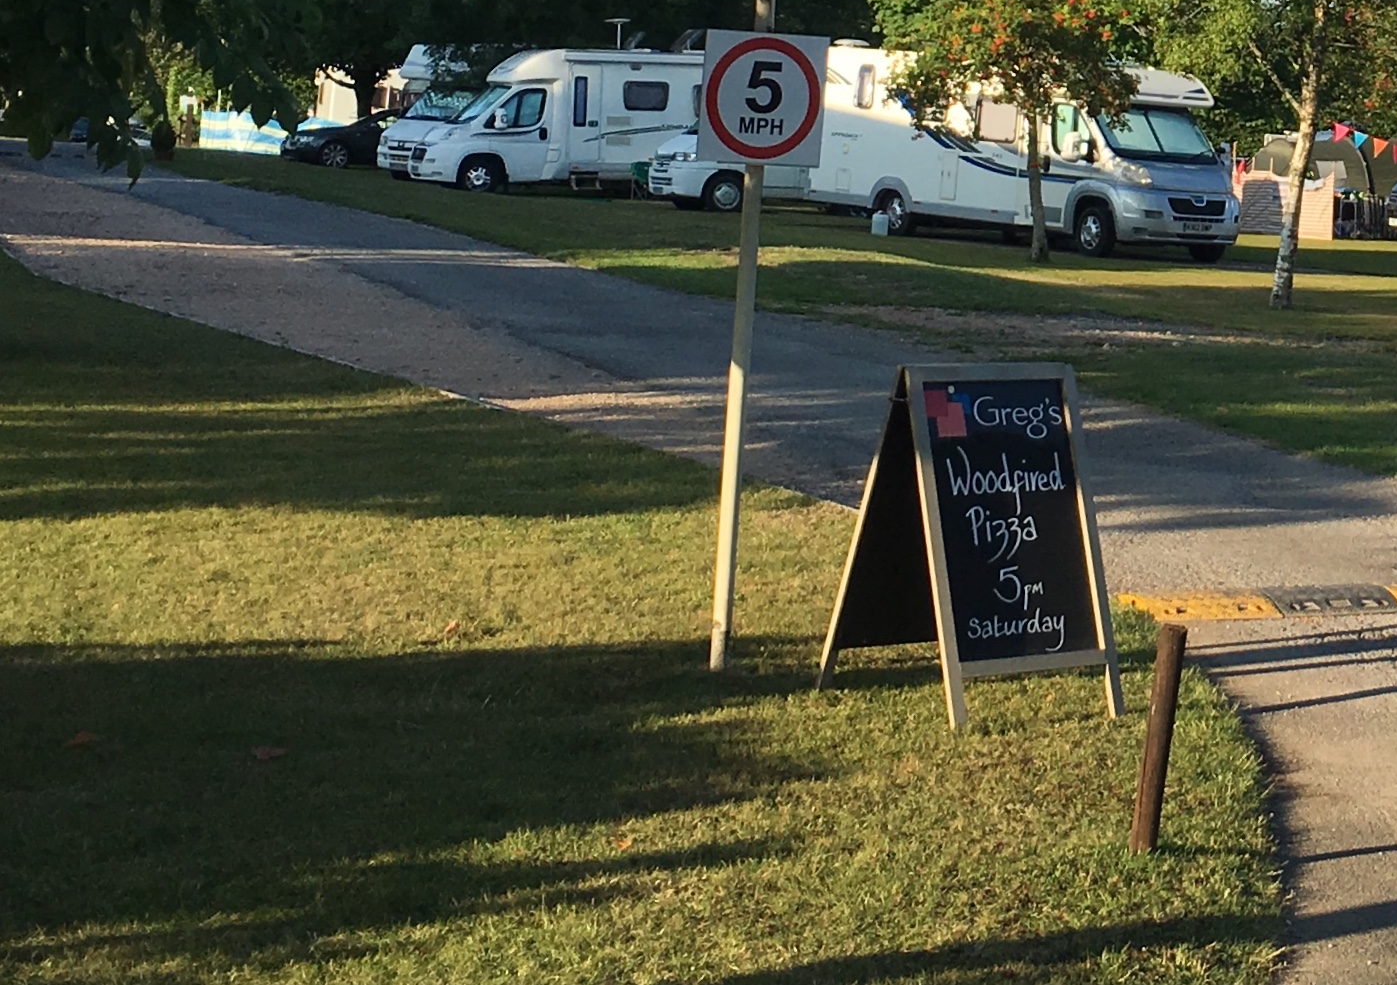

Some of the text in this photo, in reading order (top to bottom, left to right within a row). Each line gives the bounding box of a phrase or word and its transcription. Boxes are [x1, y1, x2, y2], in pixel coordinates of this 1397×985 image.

[745, 60, 783, 114] 5
[738, 116, 784, 136] MPH
[973, 396, 1063, 439] Greg's
[946, 446, 1066, 516] Woodfired
[965, 505, 1038, 563] Pizza
